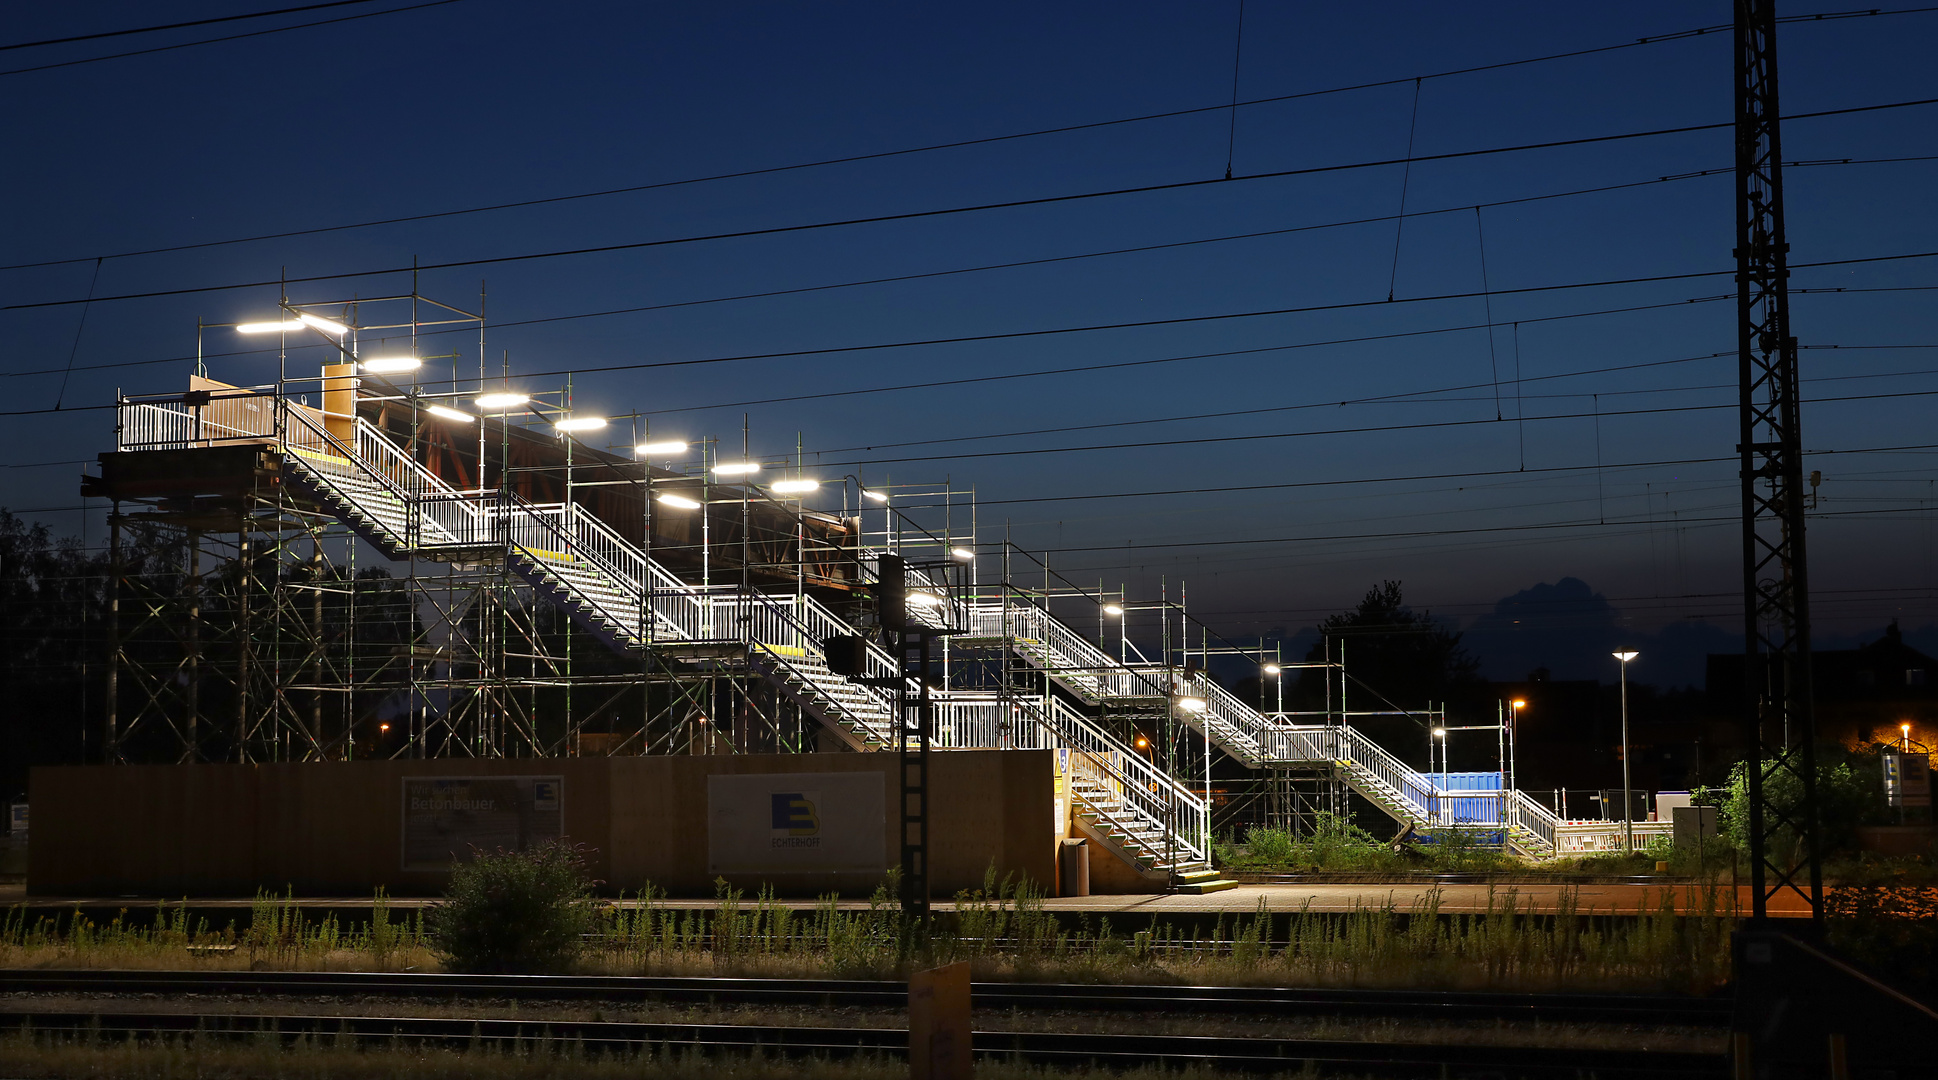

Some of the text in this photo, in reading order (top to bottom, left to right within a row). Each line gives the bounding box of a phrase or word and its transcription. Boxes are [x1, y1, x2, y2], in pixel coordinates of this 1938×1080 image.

[411, 784, 467, 795] Wir suchen
[411, 796, 497, 811] Betonbauer,
[771, 837, 821, 848] ECHTERHOFF
